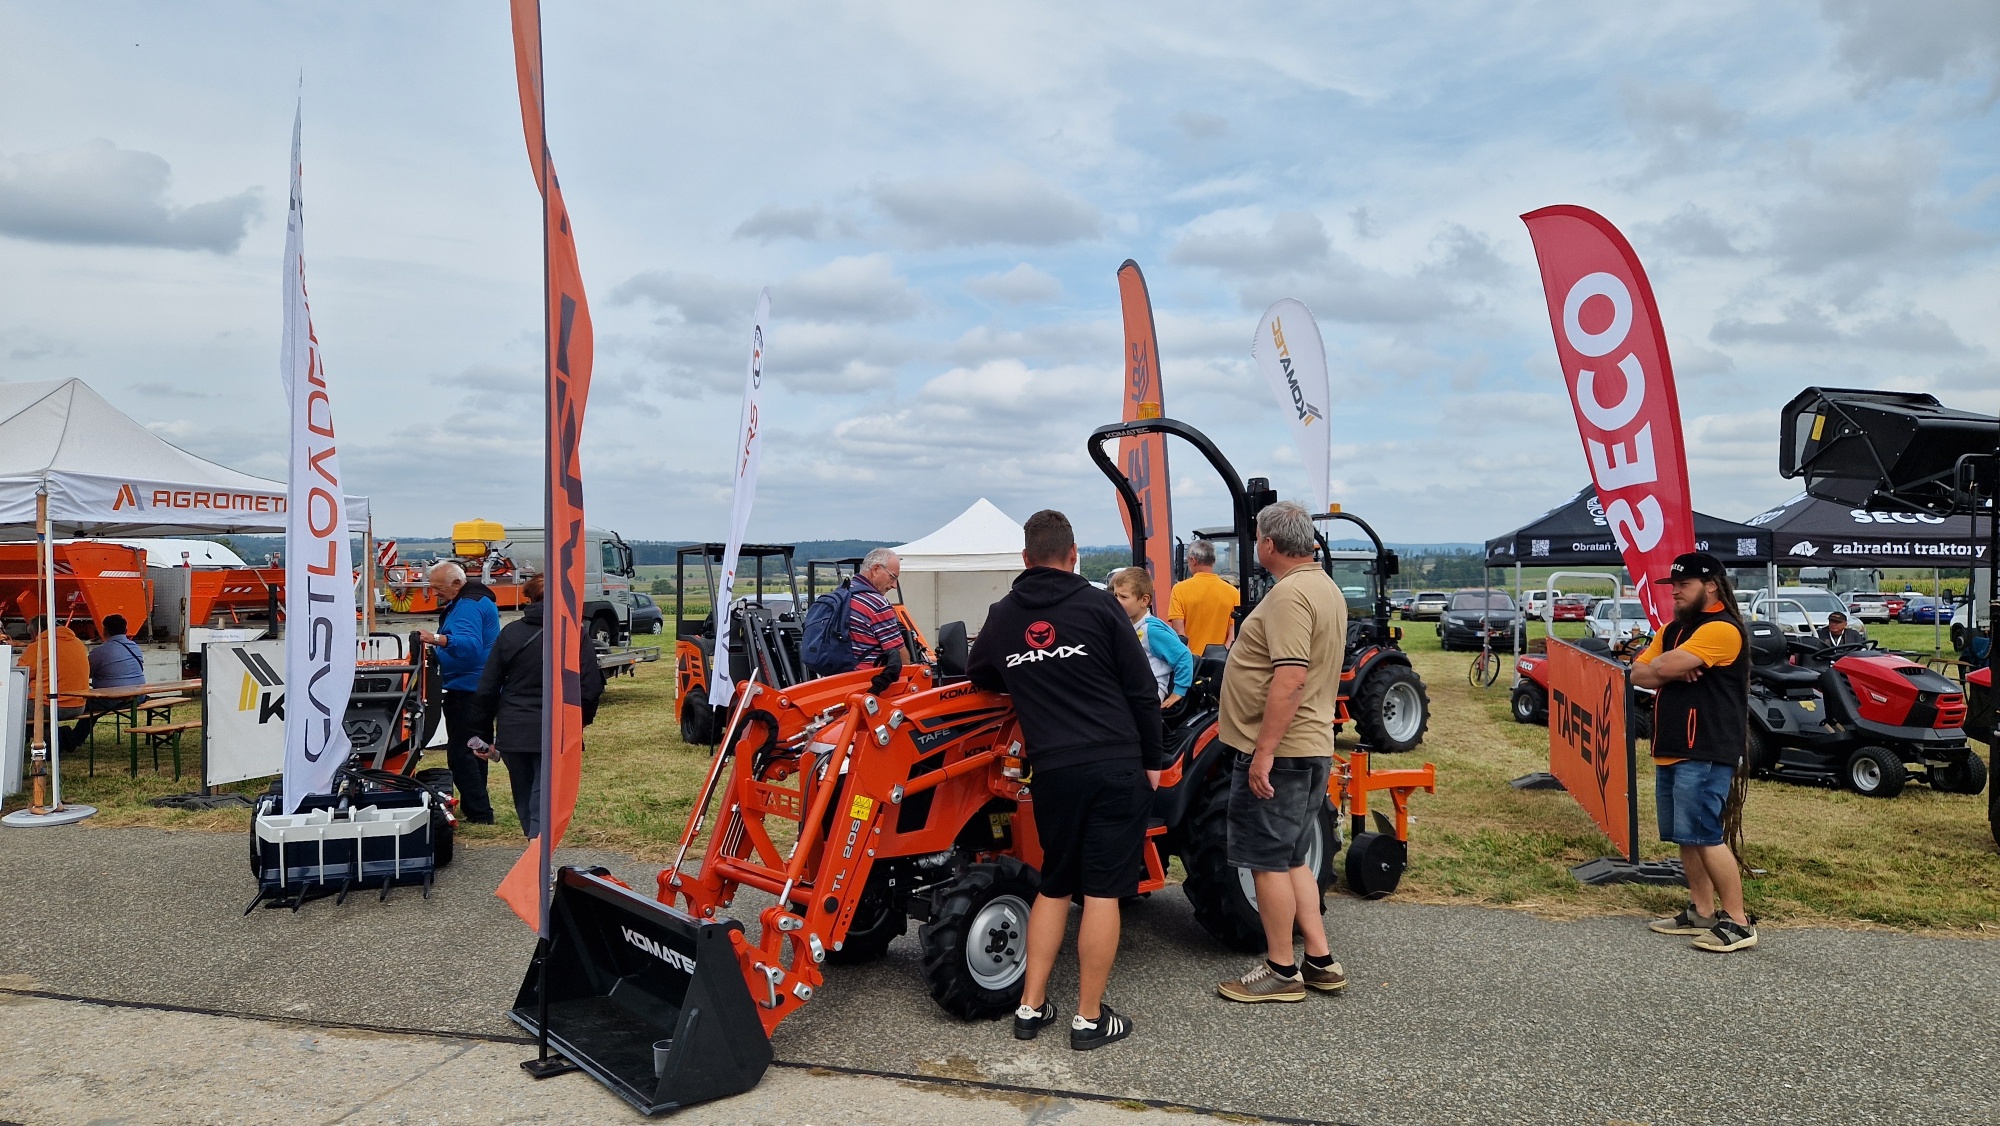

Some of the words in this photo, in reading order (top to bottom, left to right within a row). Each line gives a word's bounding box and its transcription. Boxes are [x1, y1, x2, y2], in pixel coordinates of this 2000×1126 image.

[1104, 426, 1151, 439] KOMATEC
[152, 490, 287, 513] AGROMET
[1849, 509, 1946, 524] SECO
[1832, 541, 1910, 556] zahradní
[1914, 542, 1987, 558] traktory
[1006, 644, 1089, 668] 24MX
[1519, 660, 1533, 671] SECO
[940, 685, 981, 700] KOMA
[917, 728, 951, 745] TAFE
[1553, 688, 1592, 765] TAFE
[755, 788, 800, 816] TAFE
[831, 868, 846, 892] TL
[621, 925, 697, 975] KOMATE
